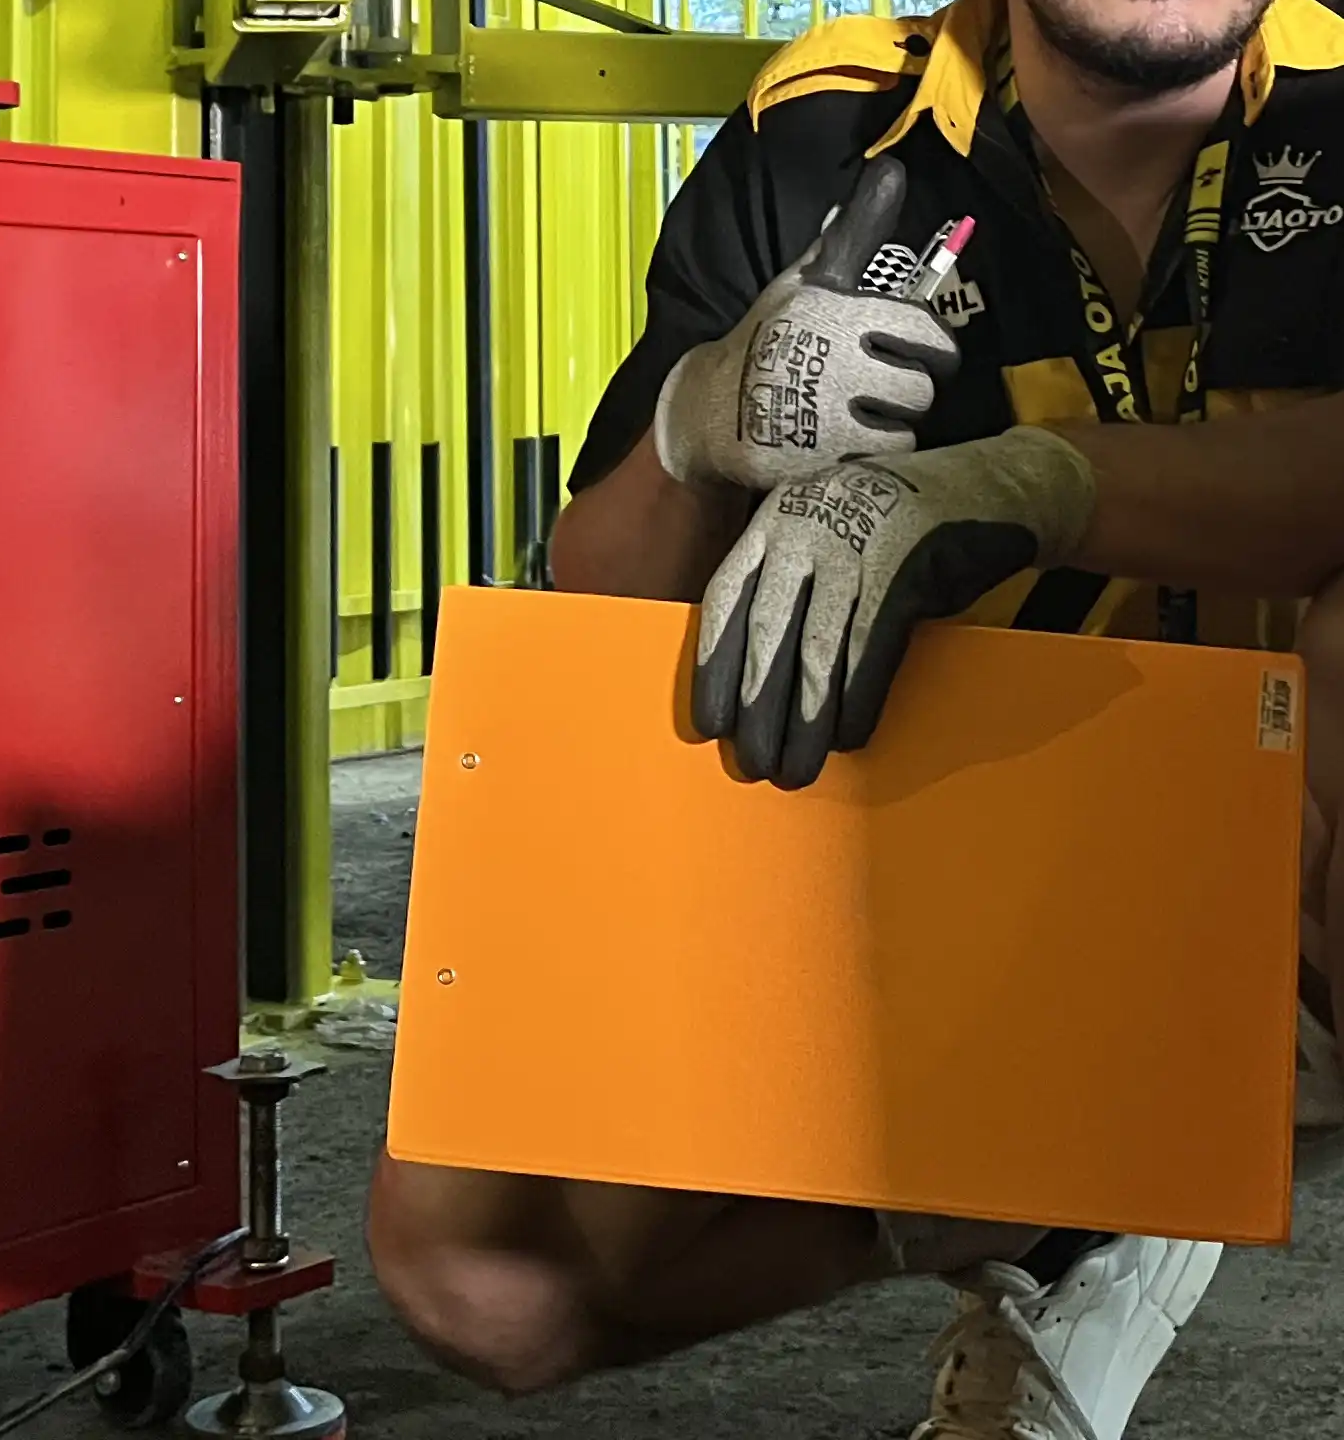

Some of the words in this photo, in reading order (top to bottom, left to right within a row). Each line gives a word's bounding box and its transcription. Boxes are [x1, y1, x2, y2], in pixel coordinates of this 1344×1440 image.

[925, 288, 979, 316] HL
[784, 328, 814, 448] SAFETY
[801, 335, 831, 450] POWER
[778, 499, 867, 556] POWER
[781, 484, 876, 537] SAFETY
